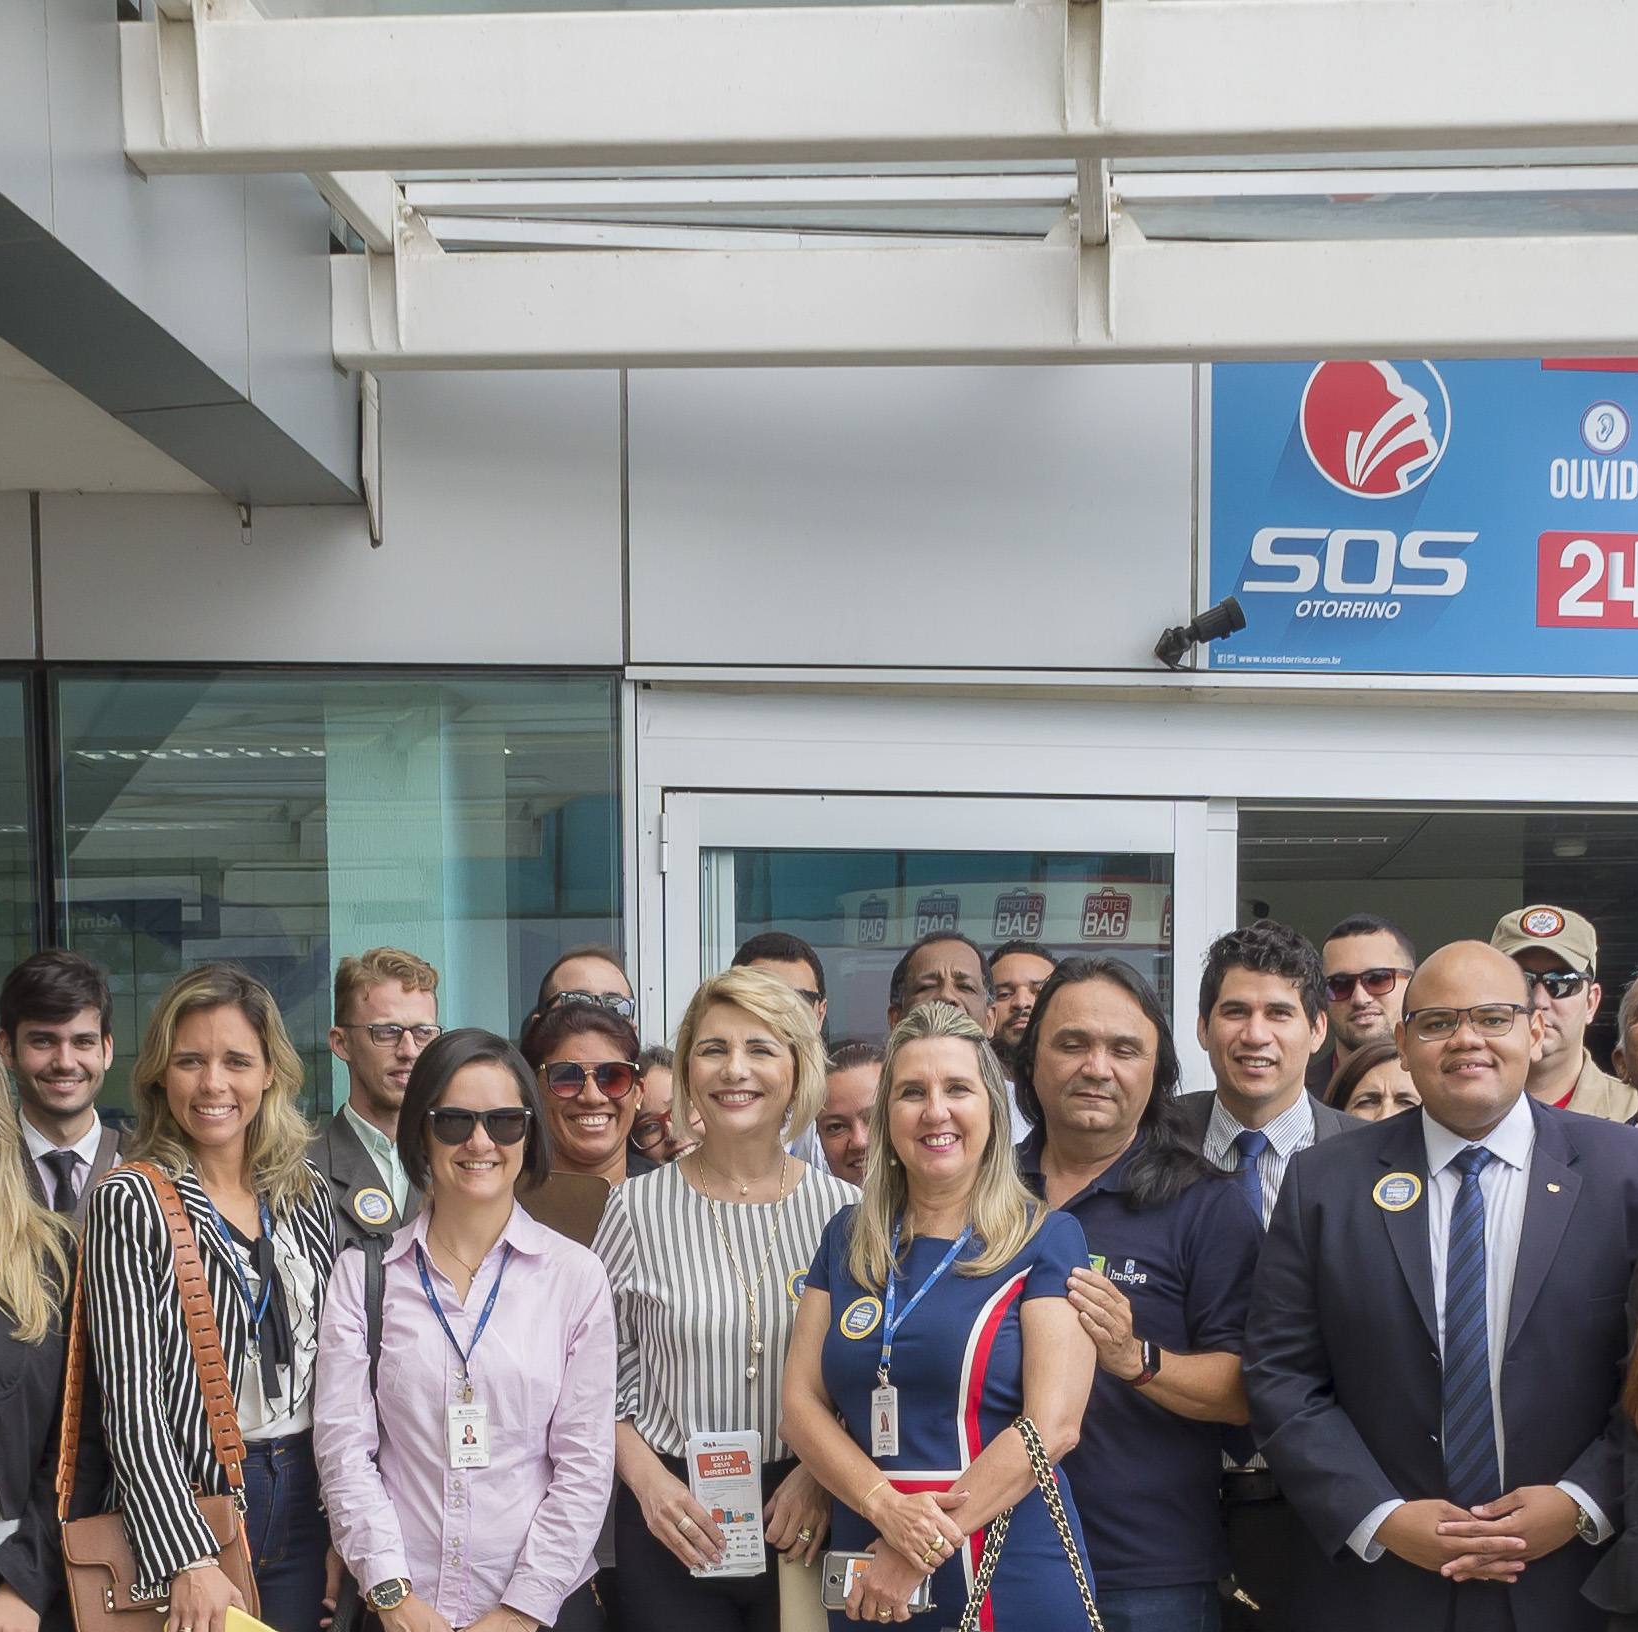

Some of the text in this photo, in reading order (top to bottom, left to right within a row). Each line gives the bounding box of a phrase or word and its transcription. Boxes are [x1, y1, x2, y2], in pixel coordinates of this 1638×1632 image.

[1242, 527, 1479, 596] SOS
[1295, 600, 1401, 619] OTORRINO
[1238, 655, 1341, 665] www.sosotorrino.com.br
[999, 900, 1040, 911] PROTEC
[1088, 899, 1127, 911] PROTEC
[996, 913, 1039, 937] BAG
[1084, 912, 1125, 936] BAG
